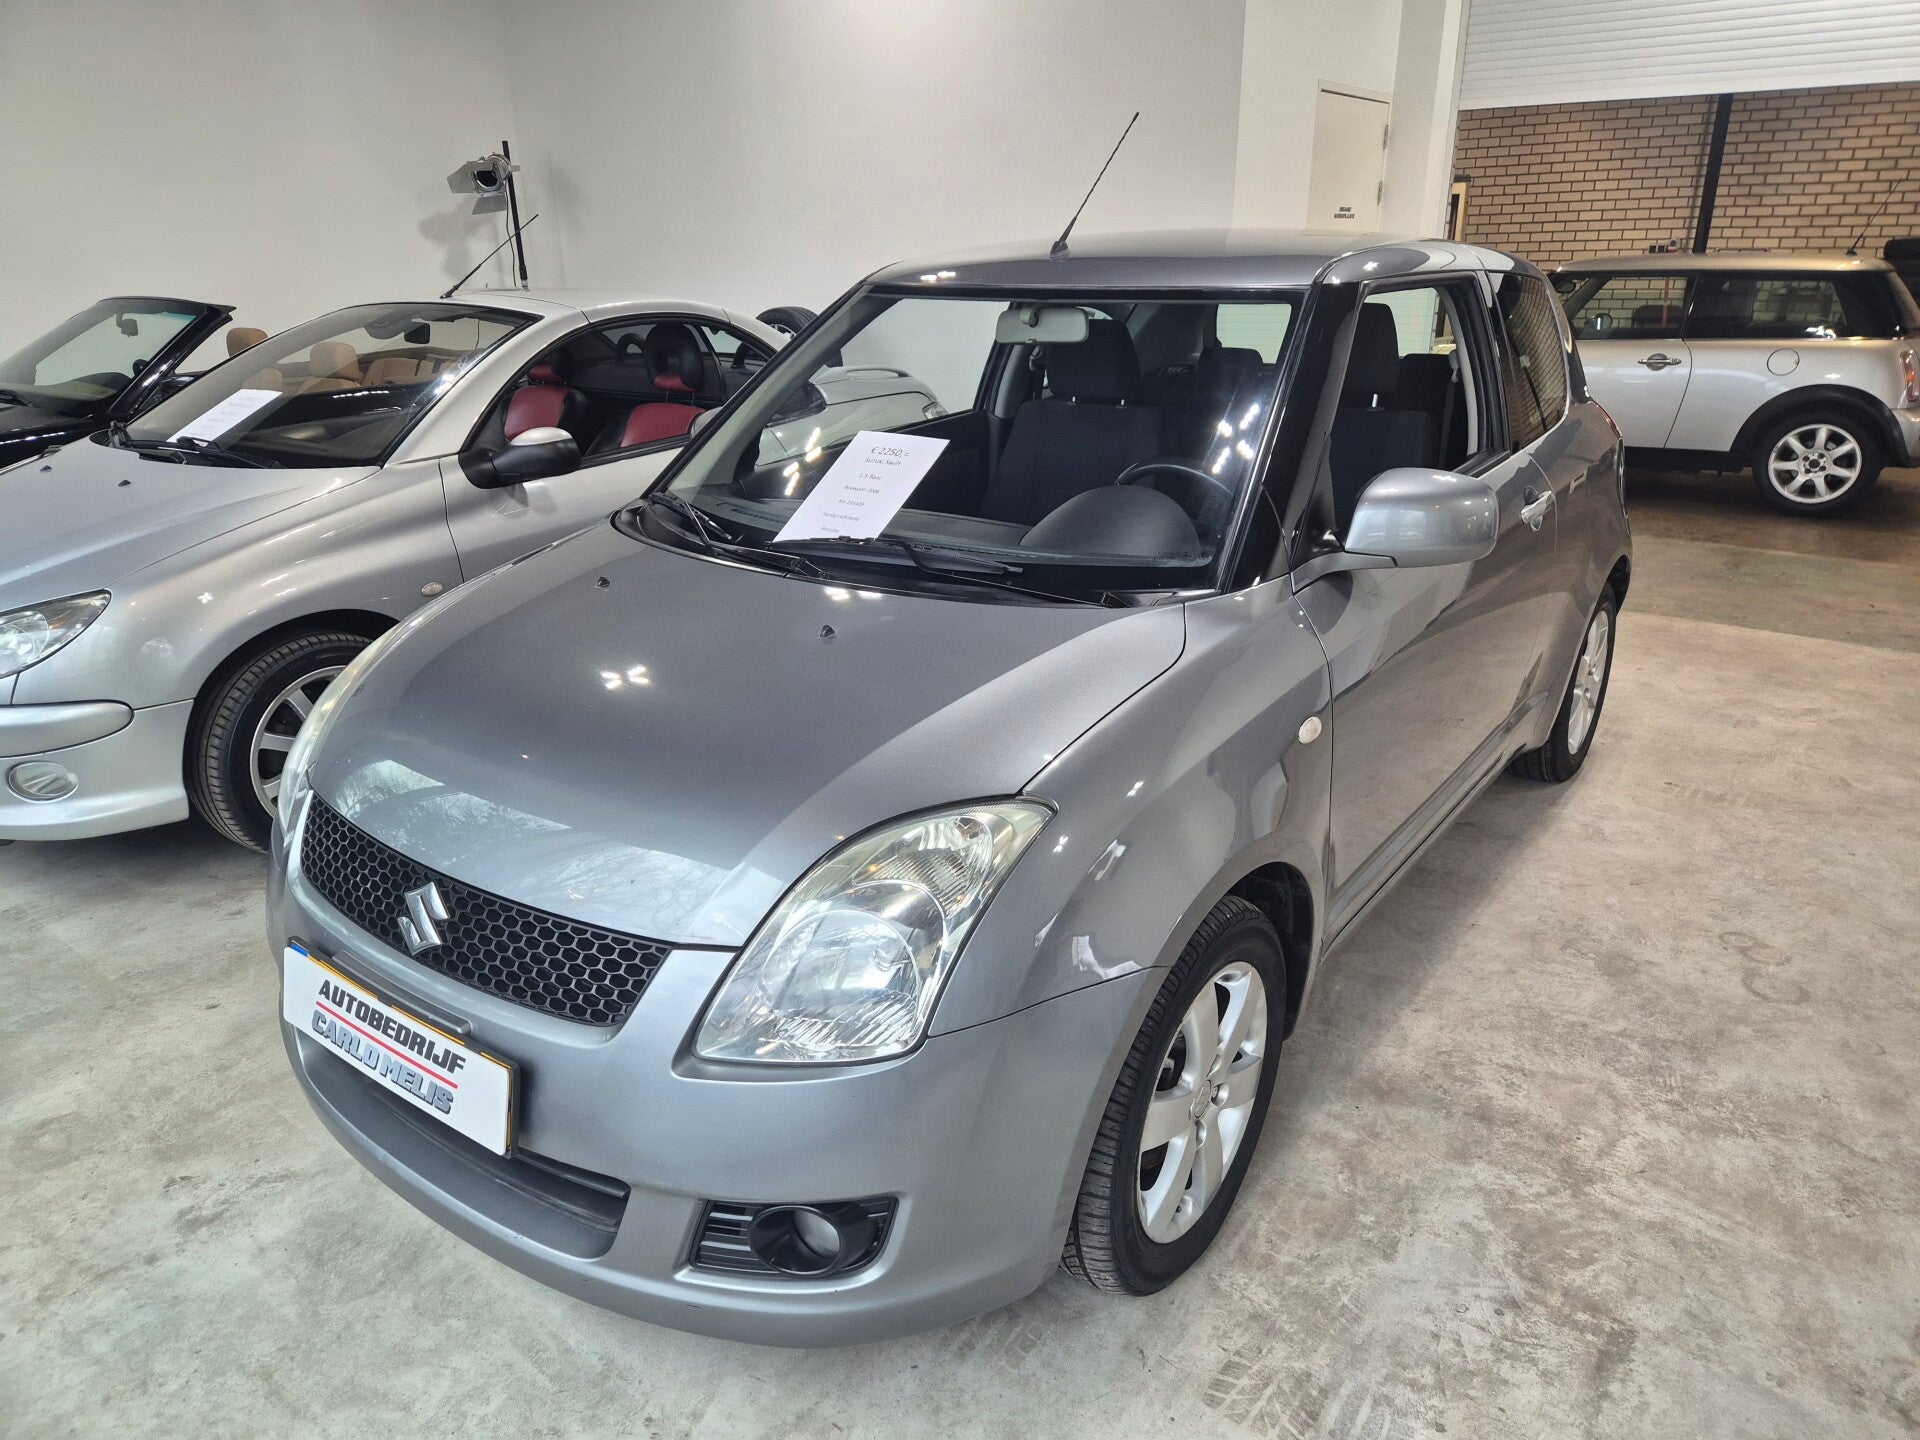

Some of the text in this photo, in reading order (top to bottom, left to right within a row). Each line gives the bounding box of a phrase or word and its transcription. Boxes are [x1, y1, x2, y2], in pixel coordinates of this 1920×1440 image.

[885, 459, 901, 467] Swift
[311, 1009, 454, 1115] CARLO MELIS
[318, 979, 466, 1074] AUTOBEDRIJF
